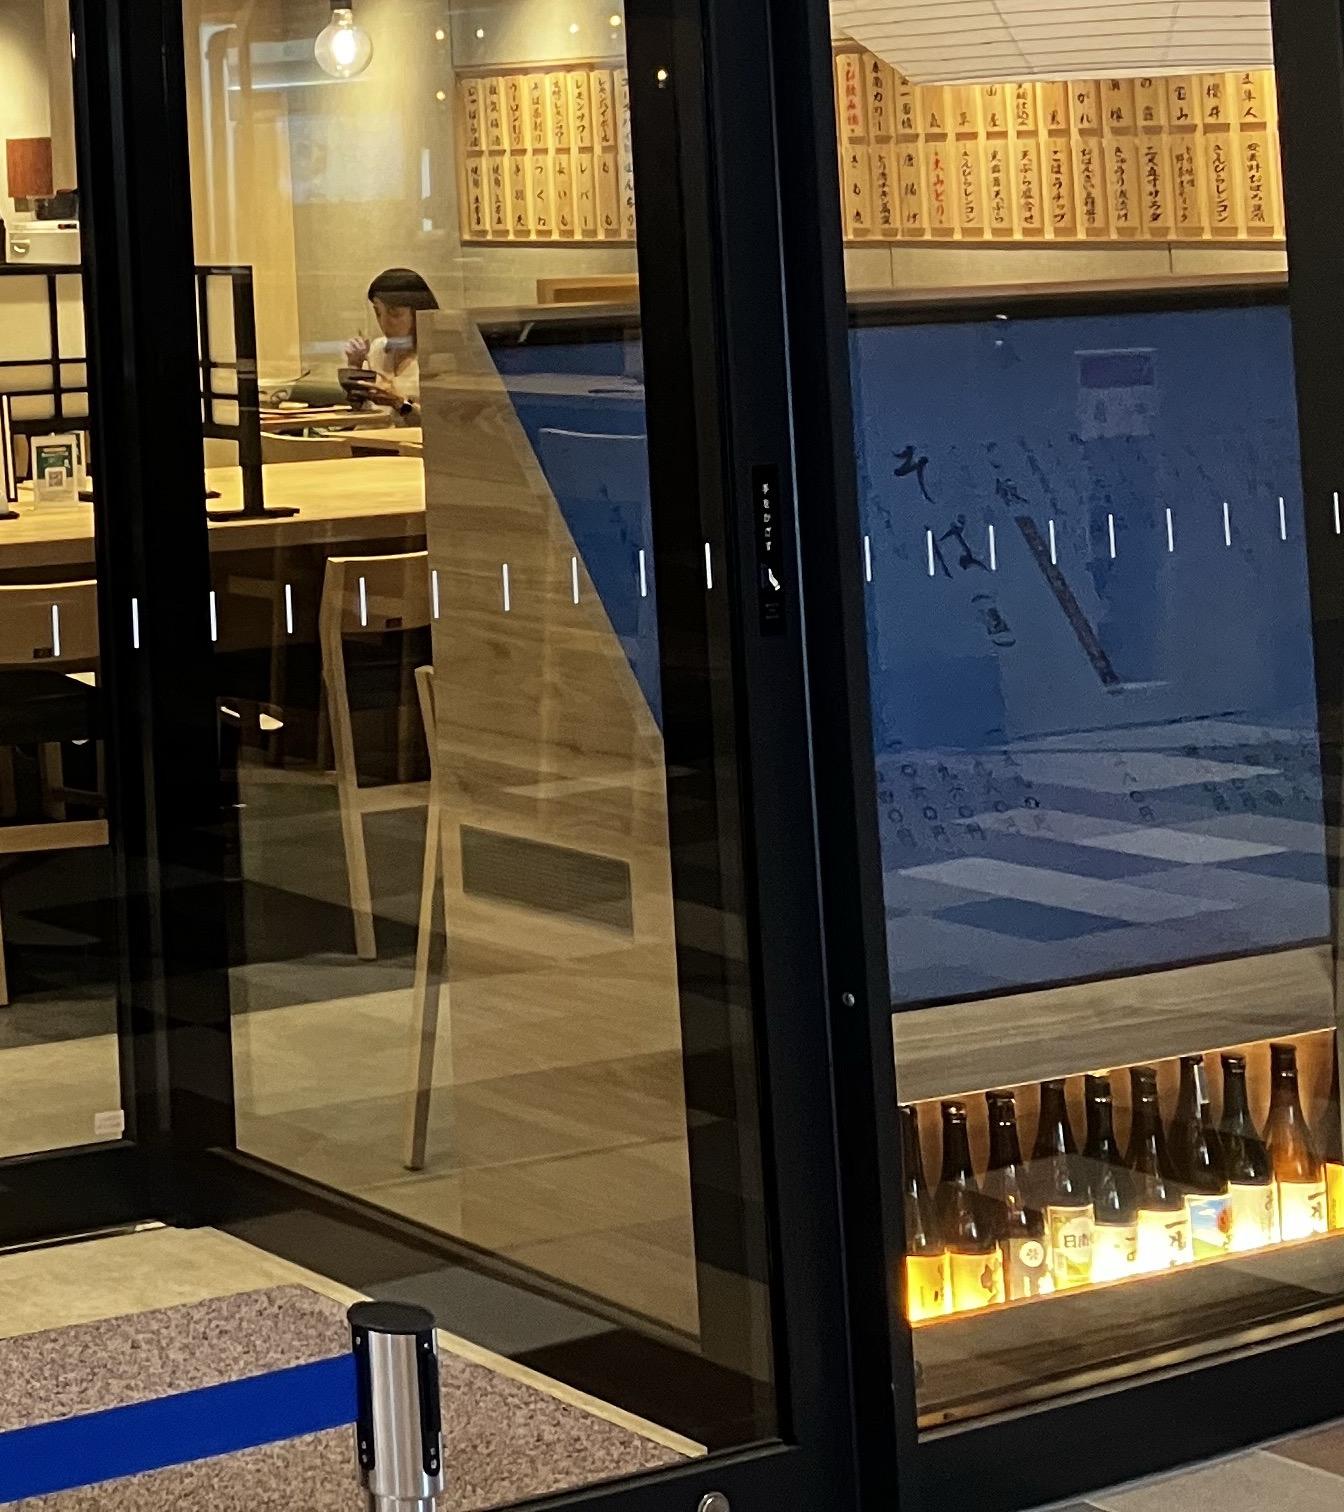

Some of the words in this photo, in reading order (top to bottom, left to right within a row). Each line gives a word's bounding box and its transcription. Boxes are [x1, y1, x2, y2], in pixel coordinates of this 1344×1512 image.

[534, 164, 547, 227] つくね
[579, 161, 591, 228] レバー
